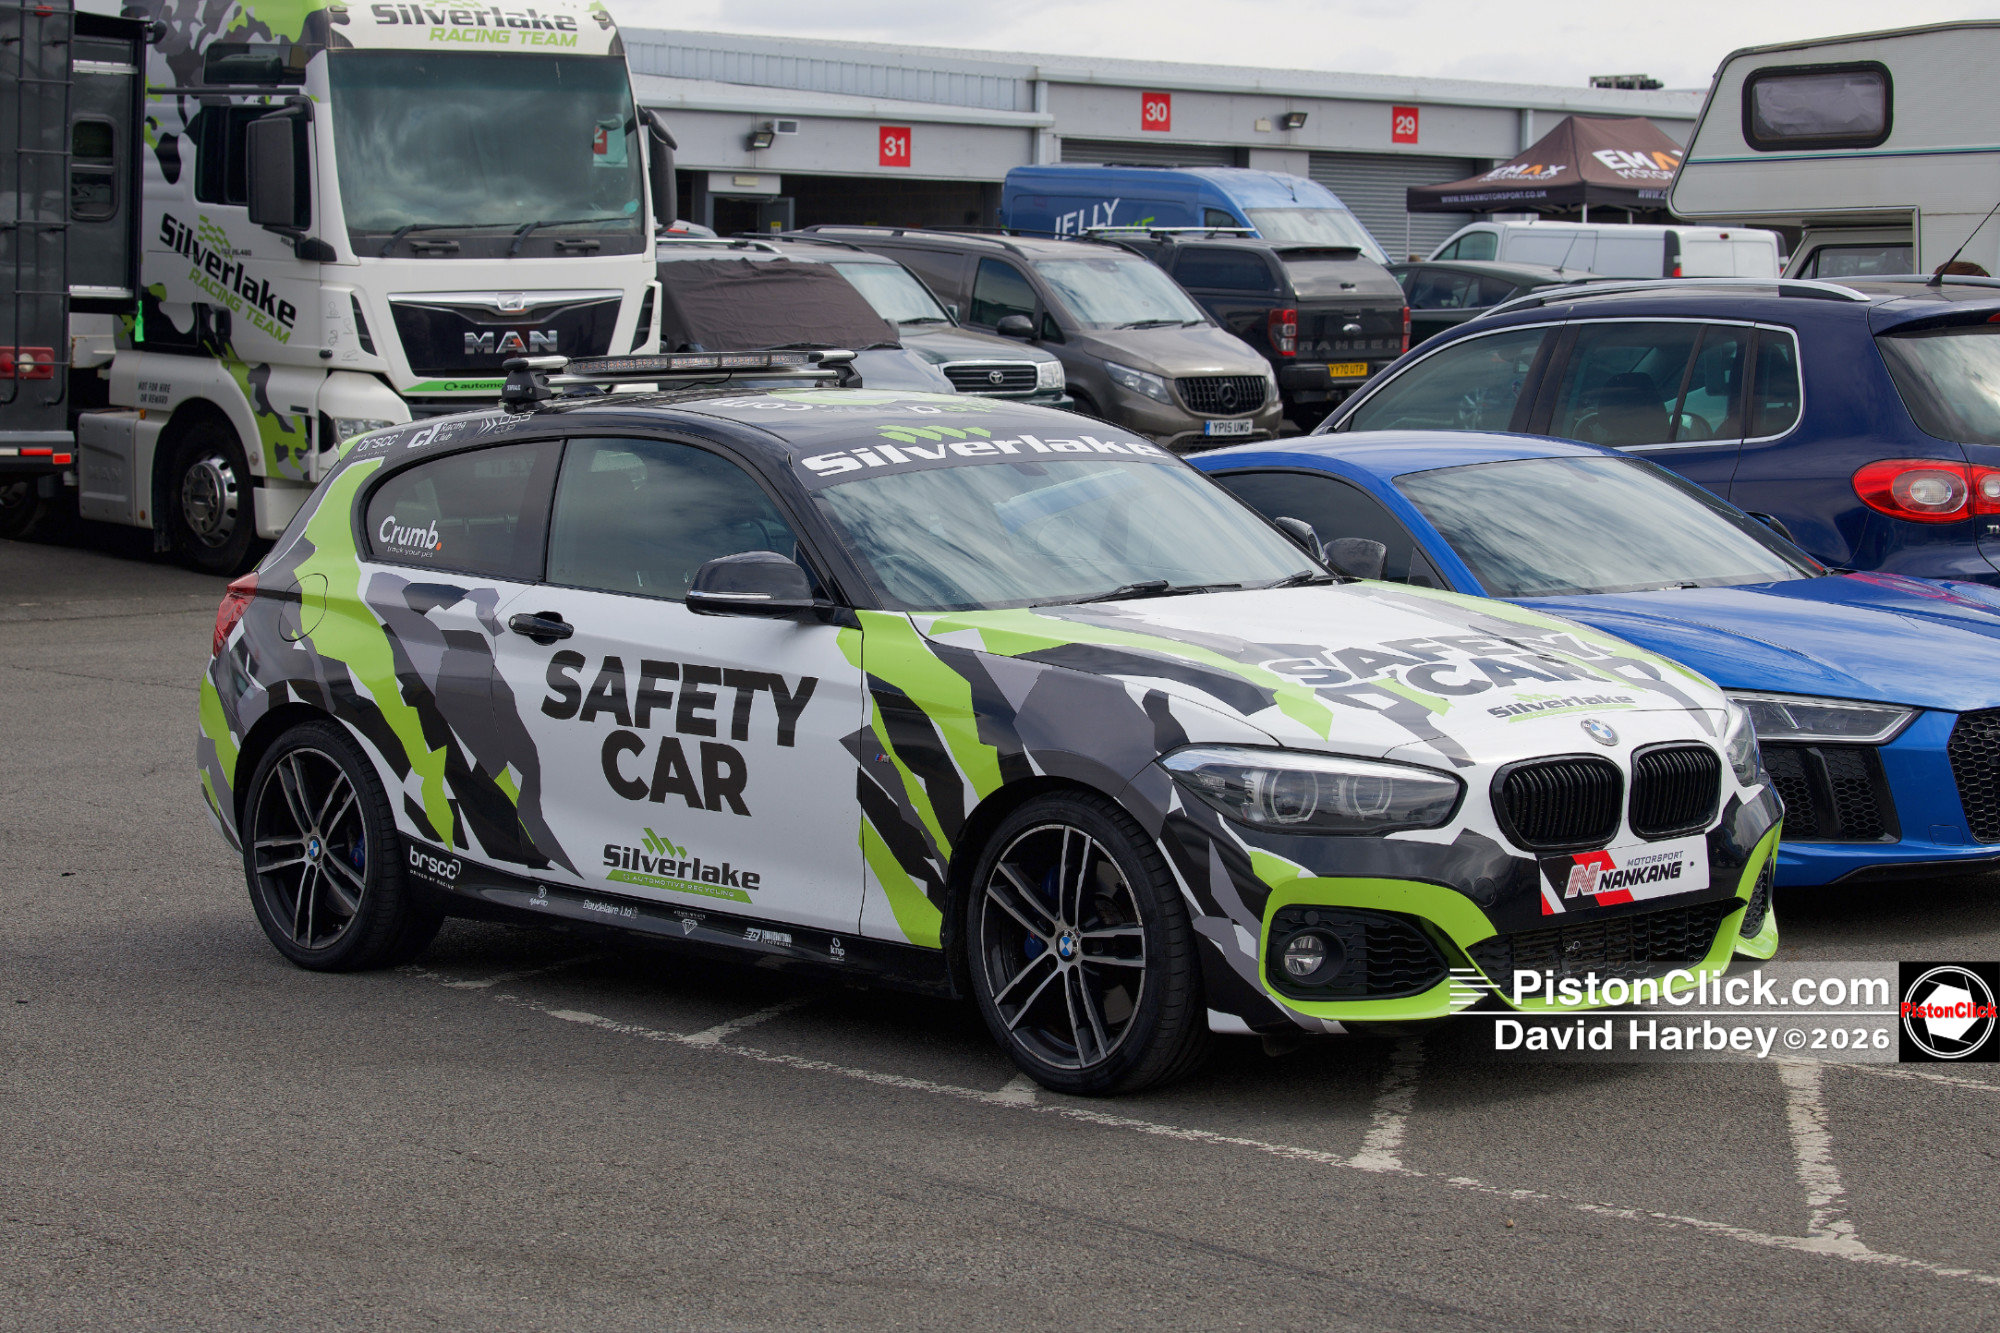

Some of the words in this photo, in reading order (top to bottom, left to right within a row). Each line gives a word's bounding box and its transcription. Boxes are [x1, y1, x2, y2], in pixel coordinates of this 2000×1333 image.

[371, 4, 577, 31] Silverlake
[429, 28, 511, 44] RACING
[518, 31, 578, 47] TEAM
[1146, 101, 1167, 122] 30
[1395, 115, 1416, 135] 29
[884, 136, 905, 157] 31
[159, 213, 296, 329] Silverlake
[188, 267, 243, 313] RACING
[246, 305, 291, 344] TEAM
[464, 330, 558, 355] MAN
[1212, 421, 1232, 434] YP15
[801, 434, 1168, 477] Silverlake
[1406, 655, 1612, 695] CAR
[541, 649, 819, 747] SAFETY
[1487, 695, 1636, 718] Silverlake
[601, 729, 752, 817] CAR
[409, 845, 461, 880] brscc
[603, 843, 760, 891] Silverlake
[1627, 850, 1684, 867] MOTORSPORT
[632, 875, 685, 890] AUTOMOTIVE
[687, 884, 735, 897] RECYCLING
[1599, 861, 1682, 891] NANKANG
[582, 899, 619, 915] Baudelaire
